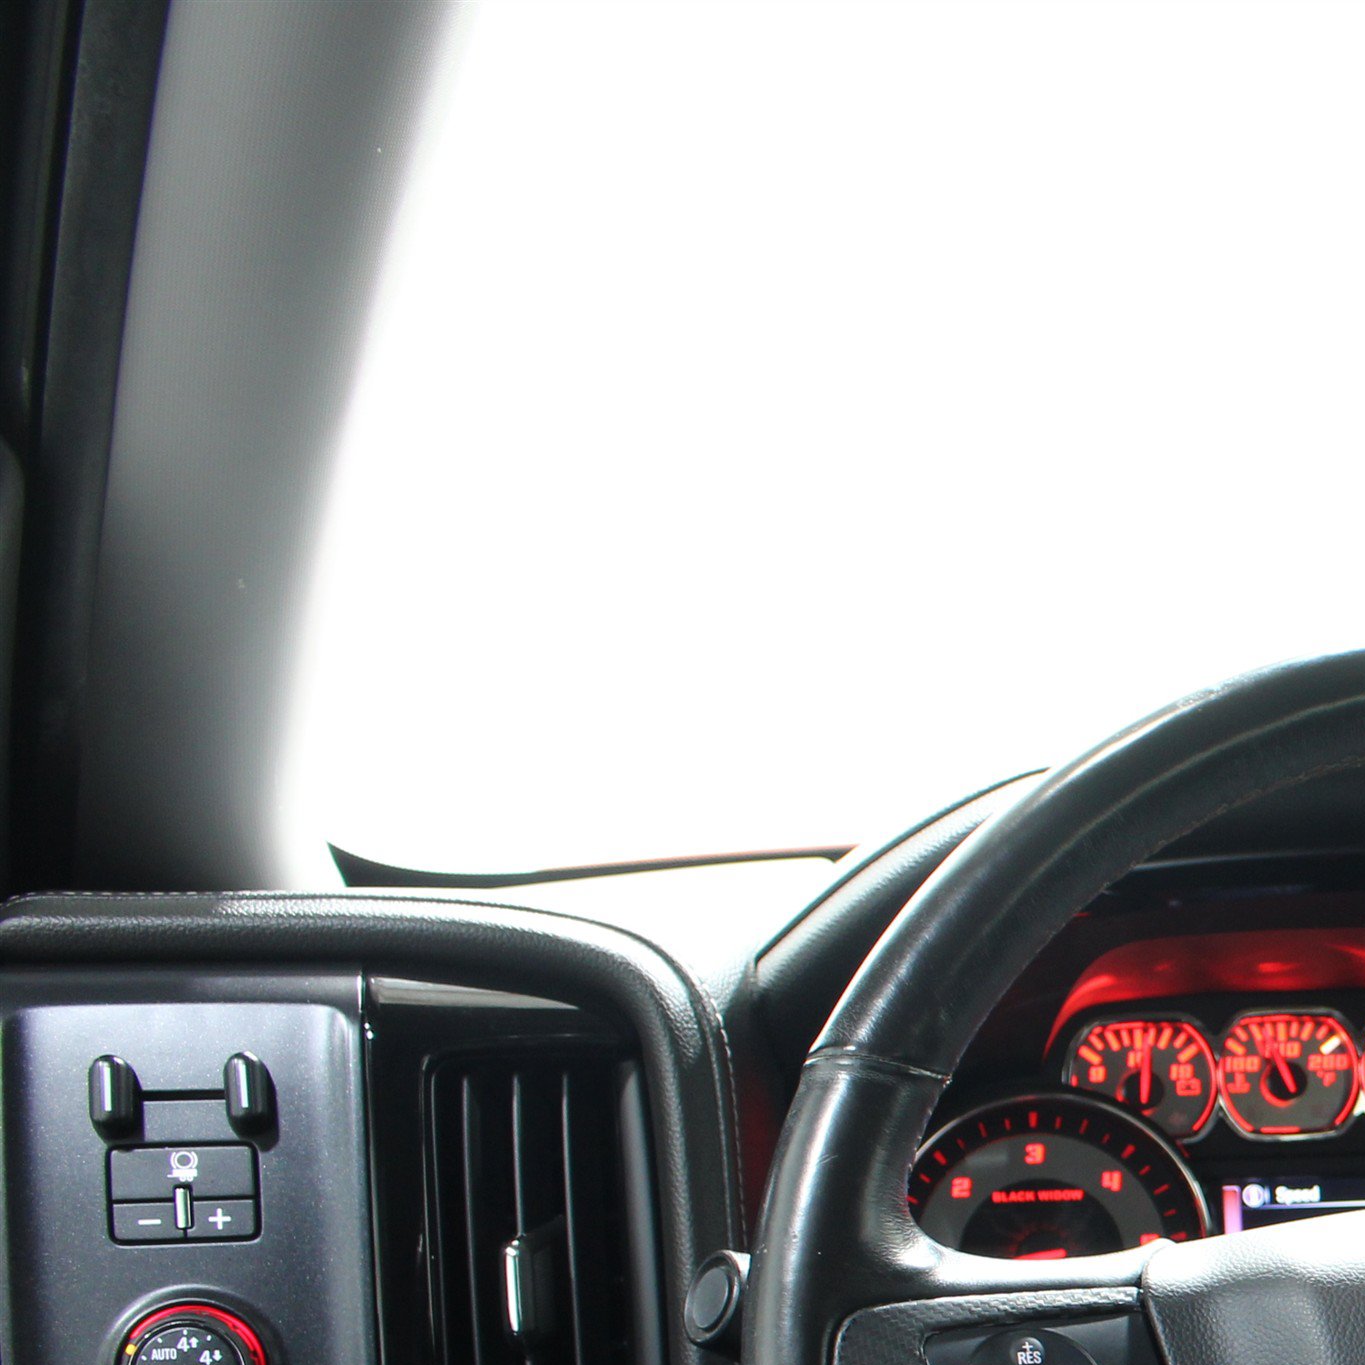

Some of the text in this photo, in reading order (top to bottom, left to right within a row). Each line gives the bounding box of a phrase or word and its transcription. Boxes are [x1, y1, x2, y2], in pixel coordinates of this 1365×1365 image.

[1024, 1142, 1046, 1165] 3
[951, 1176, 973, 1199] 2
[1101, 1169, 1123, 1192] 4
[991, 1189, 1085, 1203] BLACK WIDOW
[1275, 1184, 1321, 1206] Speed
[176, 1336, 190, 1353] 4
[151, 1348, 177, 1361] AUTO
[199, 1350, 213, 1365] 4
[1017, 1351, 1042, 1365] RES
